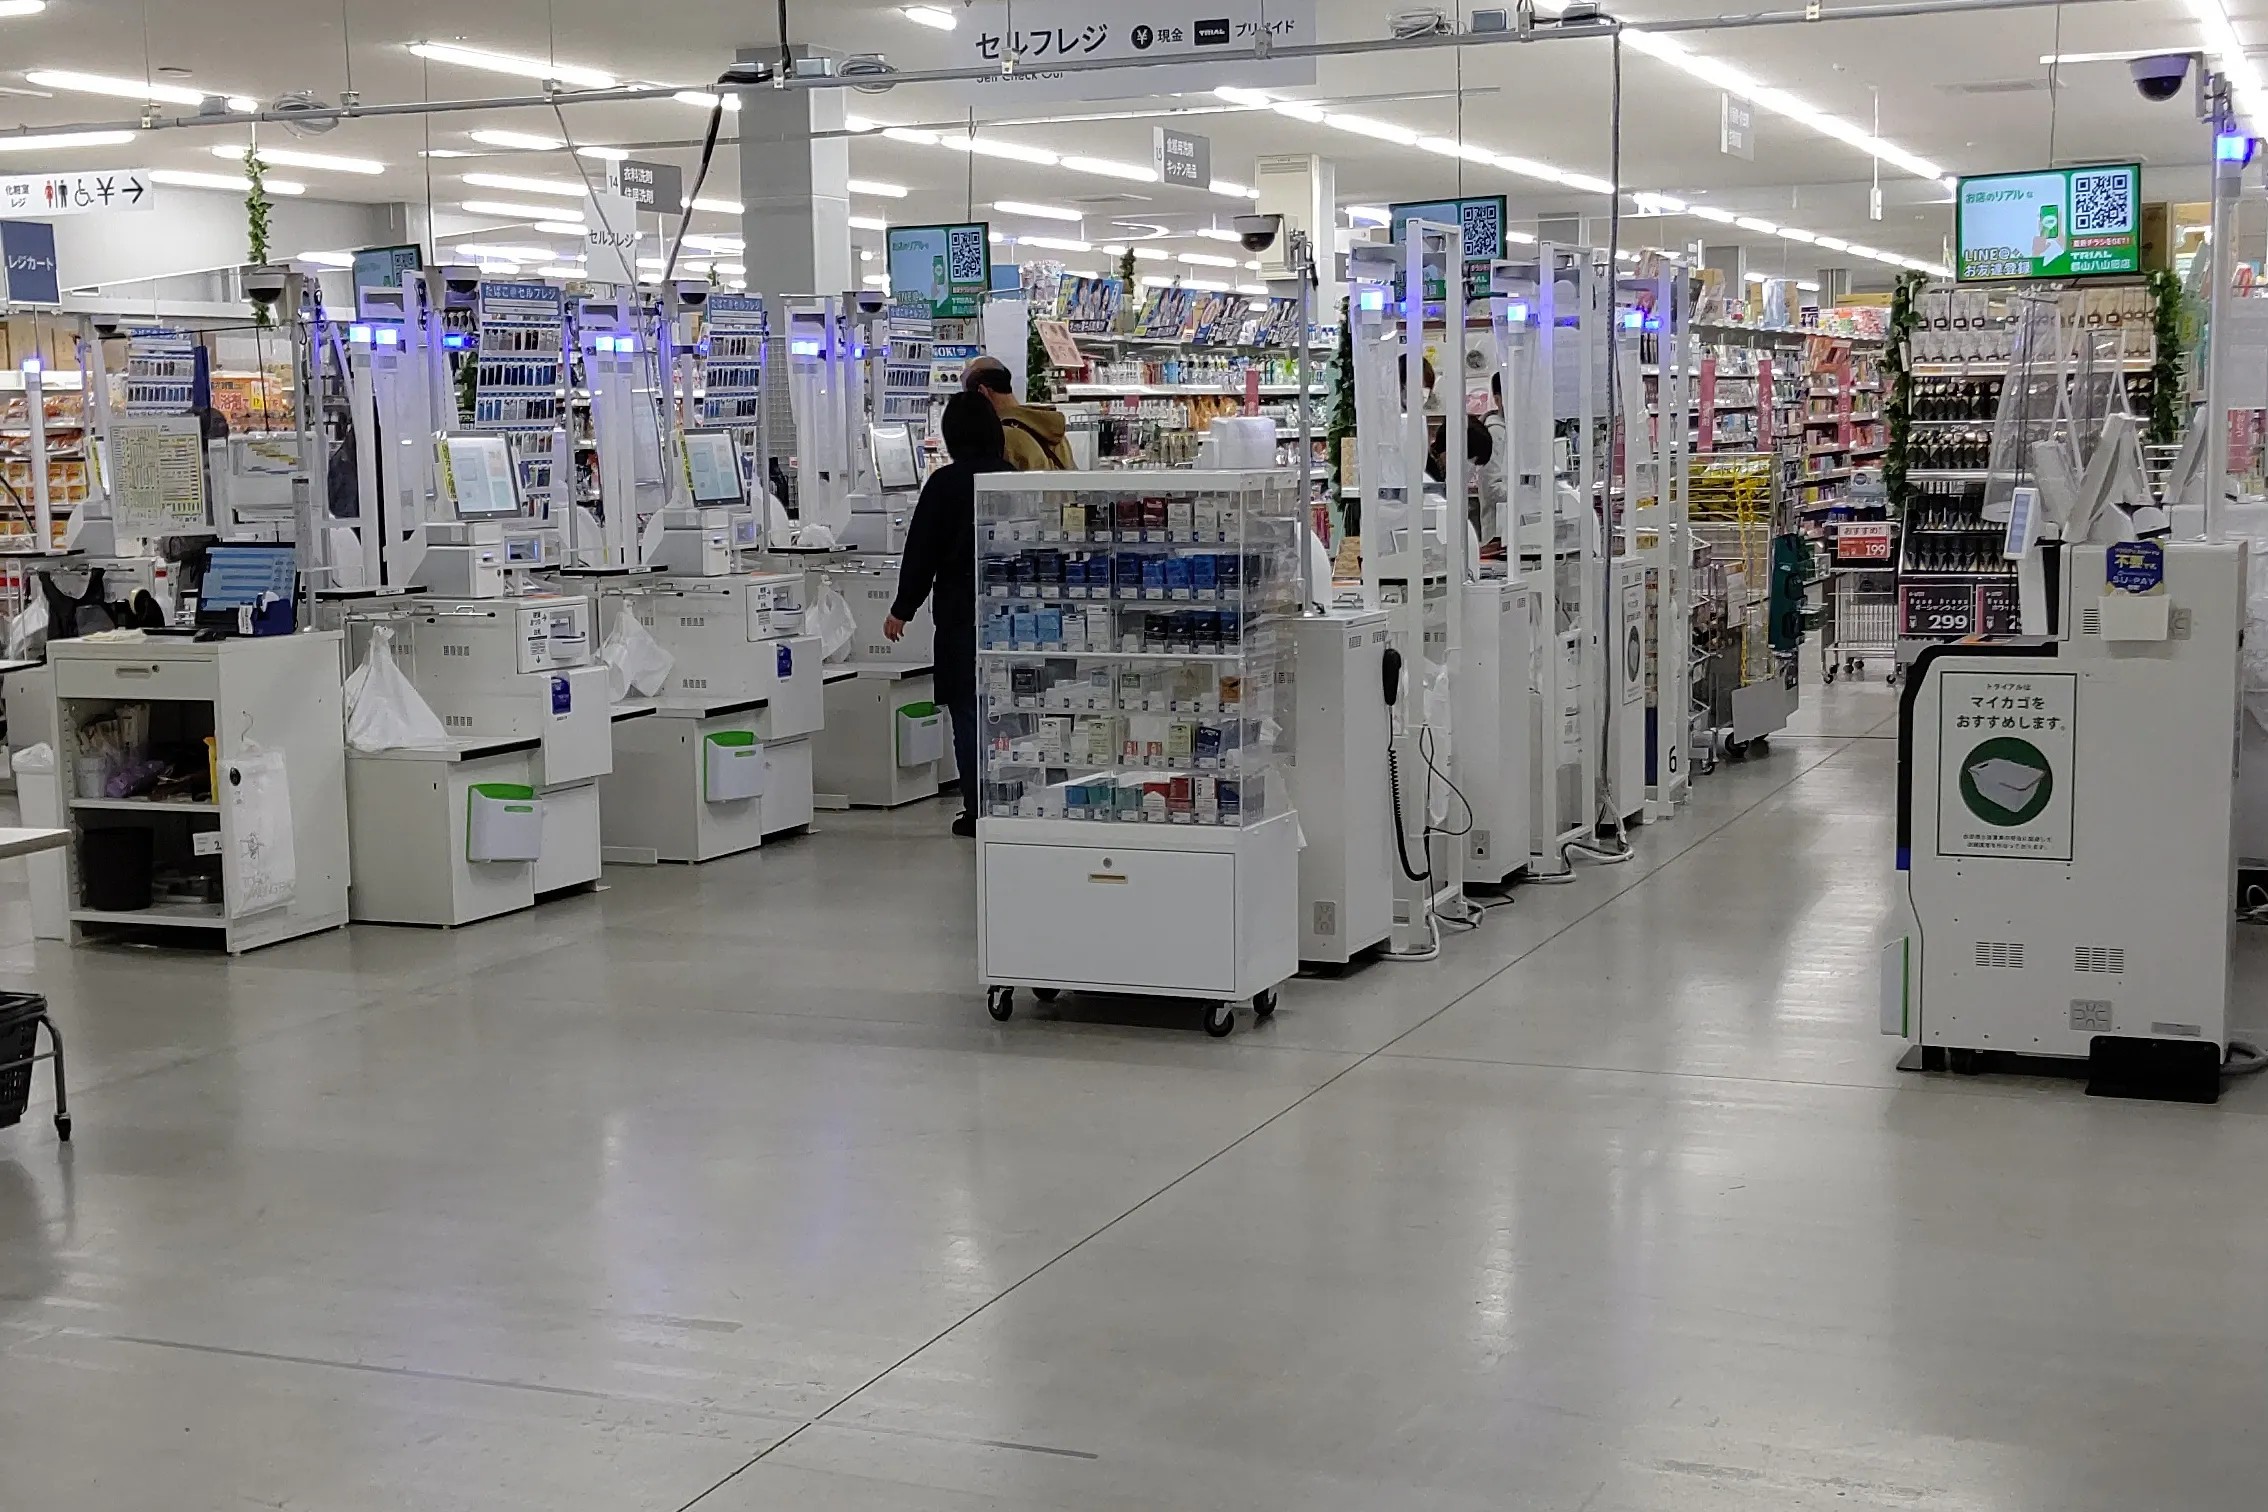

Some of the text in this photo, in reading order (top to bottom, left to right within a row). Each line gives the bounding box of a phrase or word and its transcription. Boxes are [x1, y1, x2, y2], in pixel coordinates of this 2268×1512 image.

[1157, 28, 1184, 43] 現金
[1198, 28, 1226, 37] TRIAL
[976, 23, 1108, 60] セルフレジ
[609, 176, 618, 188] 14
[623, 166, 653, 184] 衣料洗剤
[5, 184, 30, 195] 化粧室
[11, 198, 27, 208] レジ
[588, 228, 634, 248] セルフレジ
[2070, 250, 2113, 260] TRIAL
[8, 254, 54, 272] レジカート
[518, 286, 556, 300] セルフレジ
[1865, 544, 1886, 556] 199
[1928, 615, 1968, 630] 299
[1986, 683, 2033, 691] トライアルは
[1970, 696, 2046, 710] マイカゴを
[1956, 714, 2066, 732] おすすめします。
[1668, 745, 1677, 773] 6
